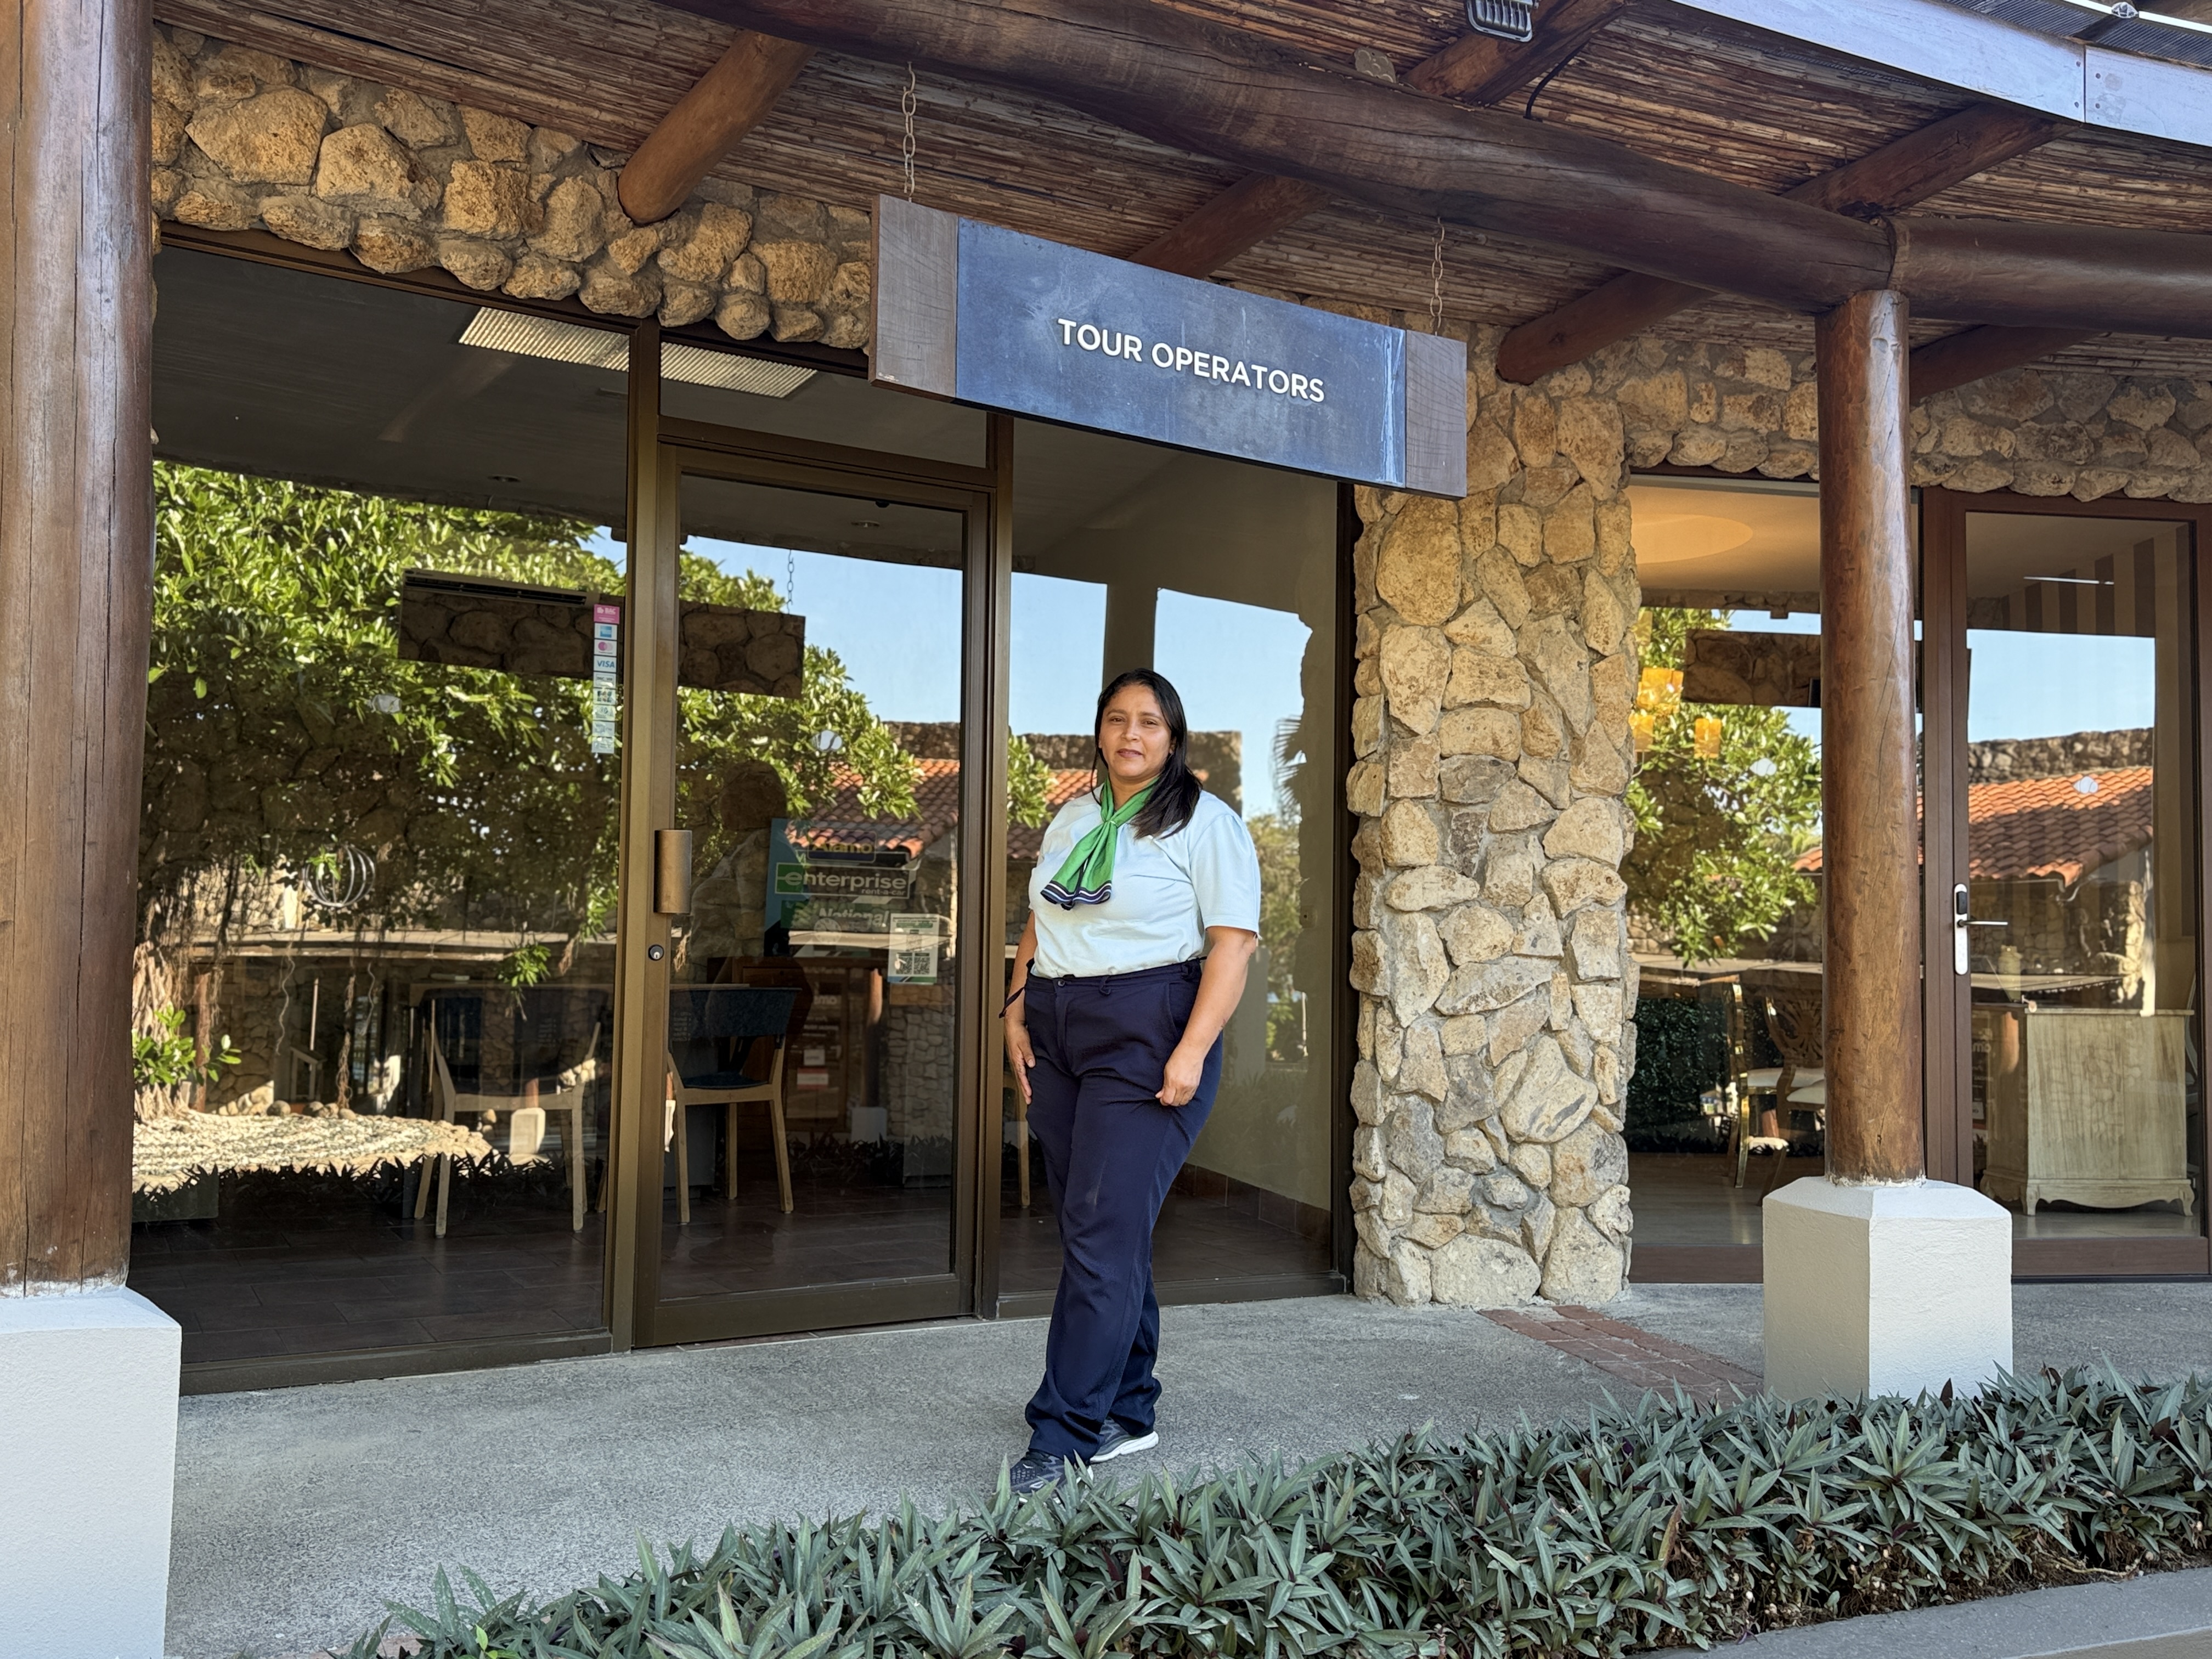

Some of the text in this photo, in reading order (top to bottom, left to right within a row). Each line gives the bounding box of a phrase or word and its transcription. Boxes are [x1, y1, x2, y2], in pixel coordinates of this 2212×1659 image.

[1058, 318, 1325, 403] TOUR OPERATORS
[597, 660, 615, 668] VISA
[785, 872, 907, 891] enterprise
